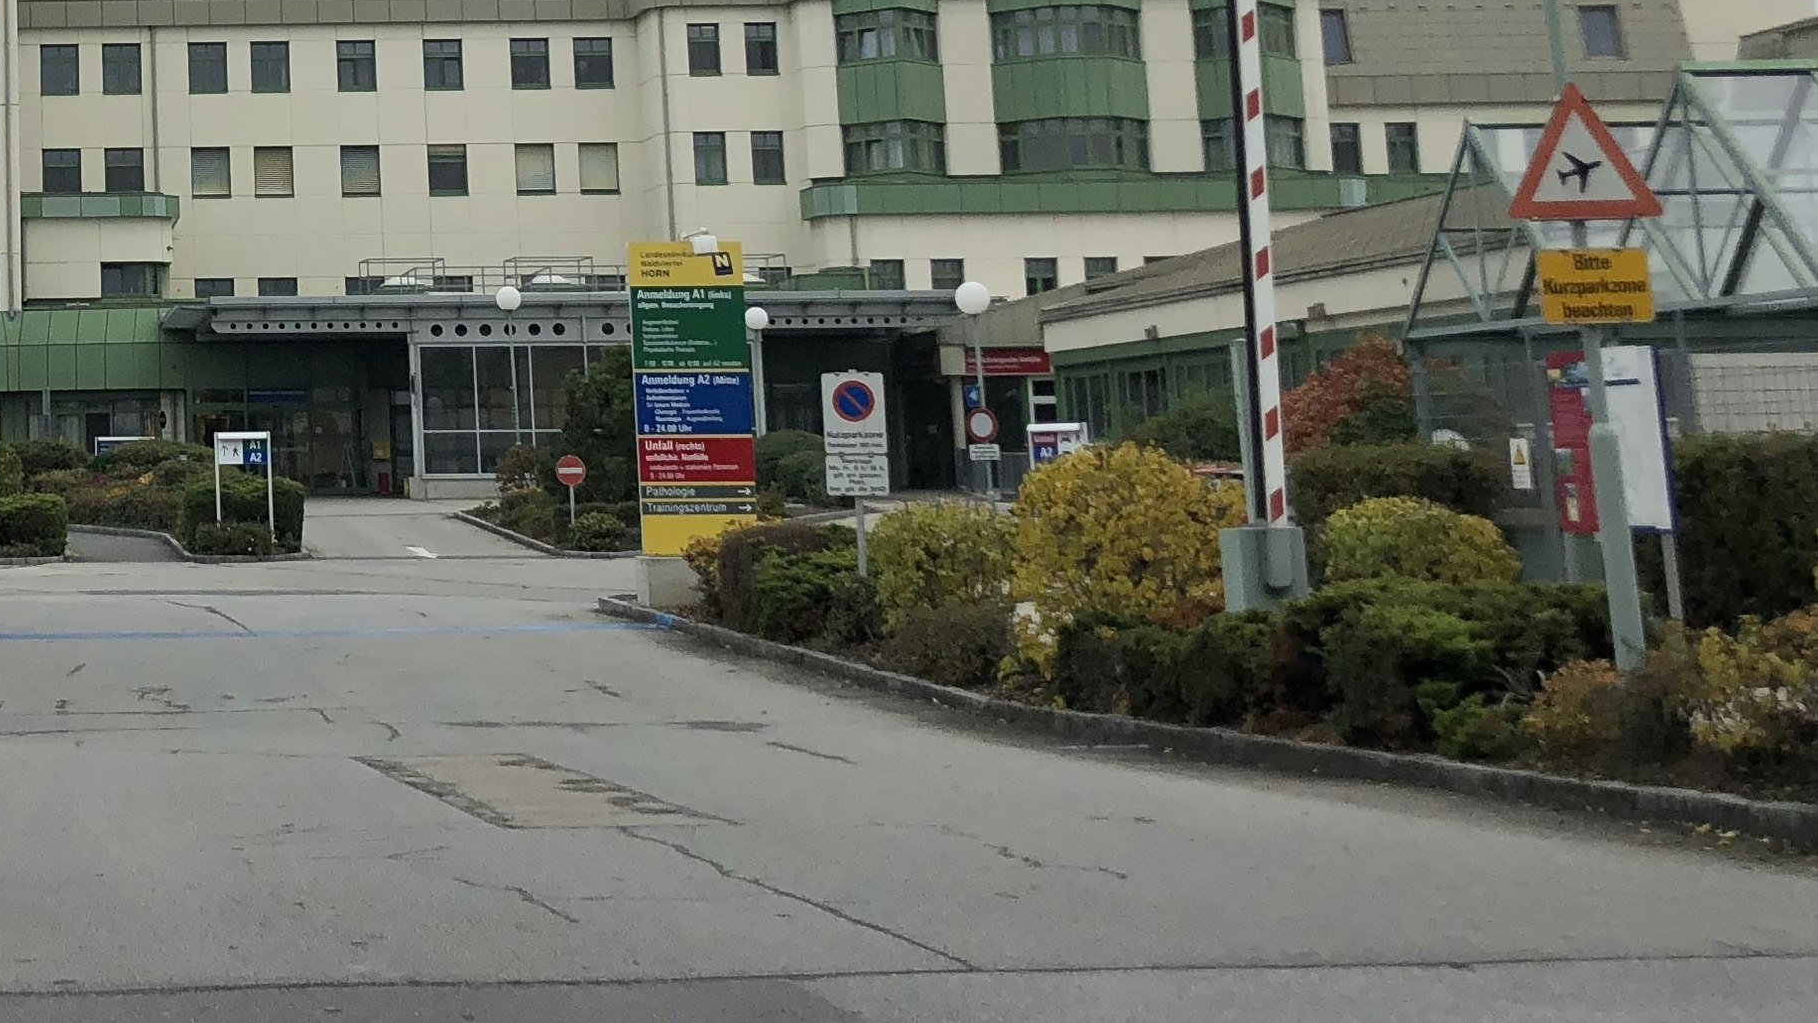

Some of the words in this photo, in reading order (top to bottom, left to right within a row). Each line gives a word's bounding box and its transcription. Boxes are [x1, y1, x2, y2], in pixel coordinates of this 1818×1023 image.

[1572, 253, 1612, 271] Bitte
[641, 269, 671, 278] HORN
[1542, 276, 1647, 298] Kurzparkzone
[637, 288, 690, 301] Anmeldung
[692, 288, 705, 299] A1
[1562, 301, 1635, 319] beachten
[641, 374, 695, 387] Anmeldung
[697, 374, 711, 385] A2
[678, 424, 693, 433] Uhr
[249, 440, 262, 449] A1
[645, 440, 674, 451] Unfall
[249, 452, 263, 463] A2
[645, 486, 696, 498] Pathologie
[647, 502, 727, 515] Trainingszentrum
